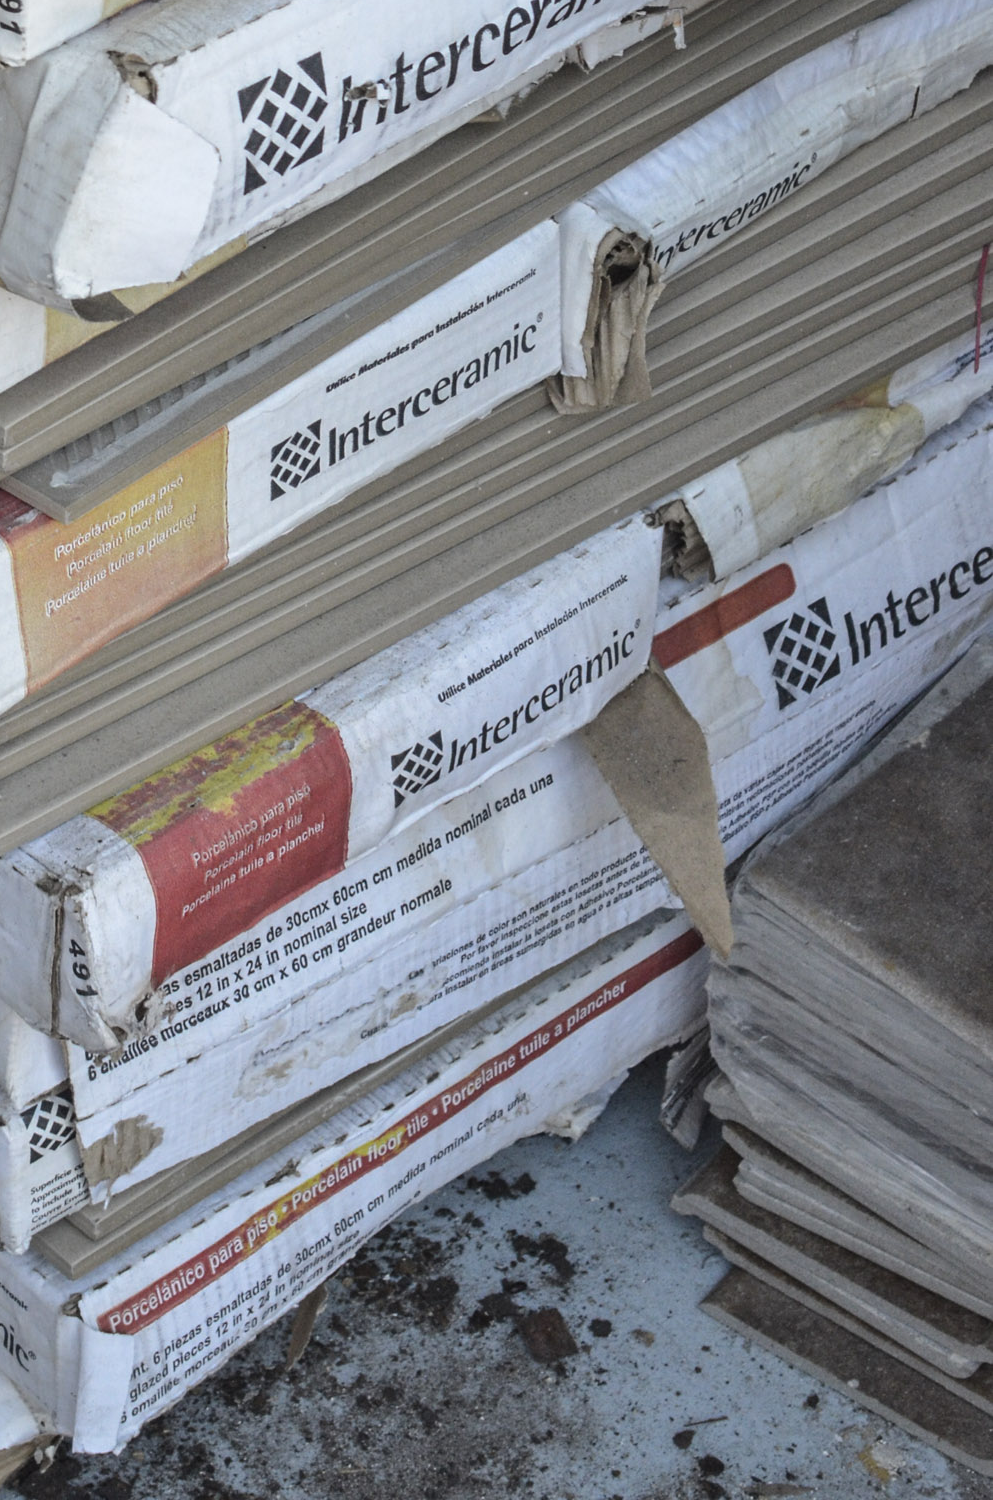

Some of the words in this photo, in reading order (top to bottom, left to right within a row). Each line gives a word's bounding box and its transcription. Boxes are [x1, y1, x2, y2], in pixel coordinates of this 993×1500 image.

[325, 372, 356, 394] Utilice
[358, 342, 410, 377] Materiales
[411, 329, 435, 351] para
[435, 300, 485, 335] Instalación
[486, 267, 537, 305] Interceramic
[54, 509, 128, 562] Porcelánico
[129, 492, 157, 521] para
[157, 475, 185, 504] piso
[67, 530, 124, 580] Porcelain
[125, 513, 153, 544] floor
[437, 681, 467, 704] Utilice
[466, 648, 514, 686] Materiales
[513, 636, 535, 656] para
[534, 607, 579, 640] Instalación
[578, 573, 629, 612] Interceramic
[184, 937, 263, 988] esmaltadas
[285, 899, 331, 933] 30cmx
[331, 879, 369, 908] 60cm
[395, 837, 443, 874] medida
[444, 802, 493, 845] nominal
[493, 787, 528, 815] cada
[529, 771, 555, 797] una
[191, 818, 259, 868] Porcelánico
[181, 873, 238, 919] Porcelaine
[67, 938, 99, 999] 491
[160, 997, 231, 1044] morceaux
[336, 915, 397, 956] grandeur
[399, 877, 453, 916] normale
[195, 981, 213, 1000] 12
[282, 915, 338, 957] nominal
[339, 900, 368, 927] size
[29, 1168, 73, 1196] Superficie
[107, 1261, 206, 1334] Porcelánico
[208, 1234, 245, 1274] para
[246, 1209, 280, 1250] piso
[290, 1156, 364, 1212] Porcelain
[366, 1128, 405, 1164] floor
[405, 1110, 430, 1139] tile
[440, 1053, 517, 1114] Porcelaine
[519, 1030, 552, 1062] tuile
[566, 978, 629, 1034] plancher
[164, 1320, 203, 1358] piezas
[205, 1274, 274, 1327] esmaltadas
[294, 1230, 333, 1267] 30cmx
[333, 1207, 365, 1236] 60cm
[387, 1159, 427, 1199] medida
[429, 1127, 475, 1166] nominal
[129, 1366, 170, 1404] glazed
[171, 1334, 213, 1372] pieces
